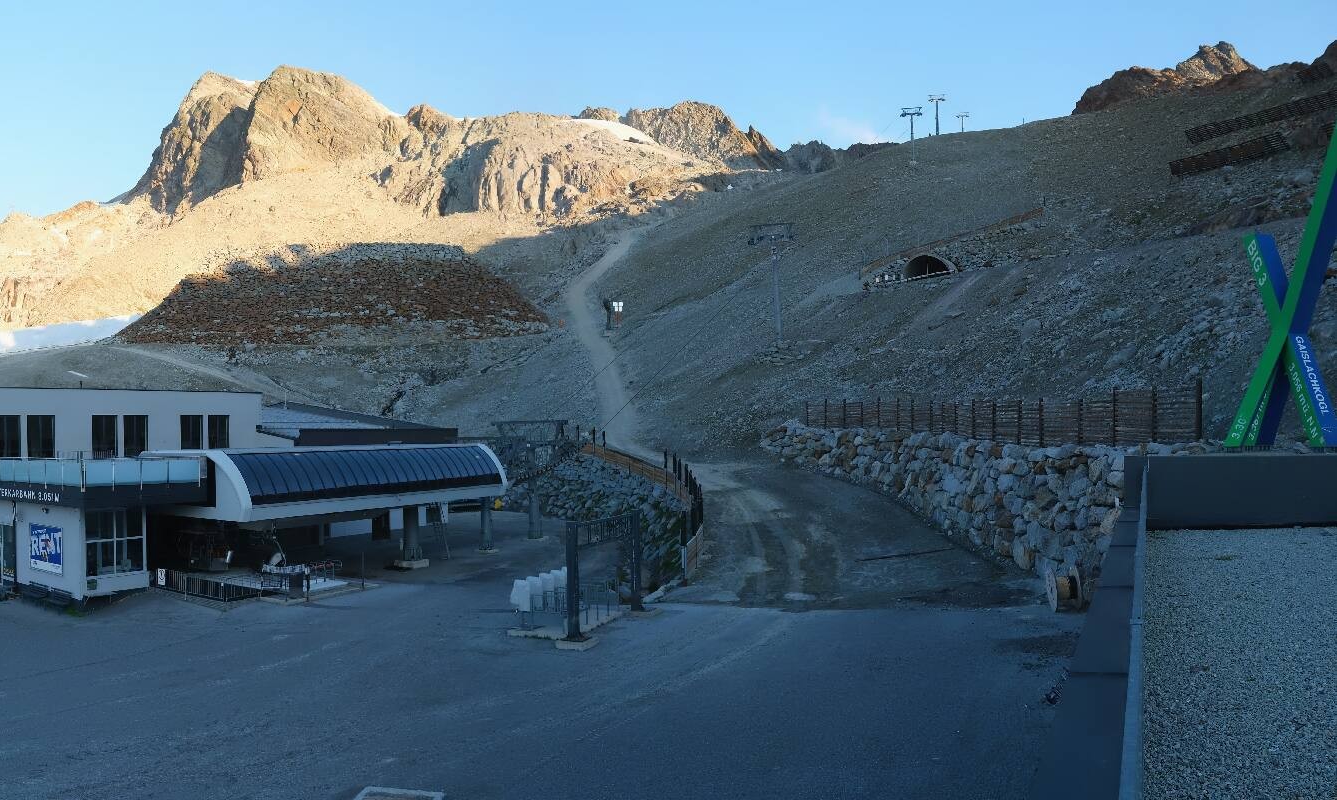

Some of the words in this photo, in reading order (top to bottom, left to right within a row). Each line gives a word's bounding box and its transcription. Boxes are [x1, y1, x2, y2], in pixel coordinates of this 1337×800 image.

[1247, 239, 1263, 273] BIG
[1258, 273, 1267, 286] 3
[1295, 335, 1330, 417] GAISLACHKOGL
[31, 532, 62, 555] RENT
